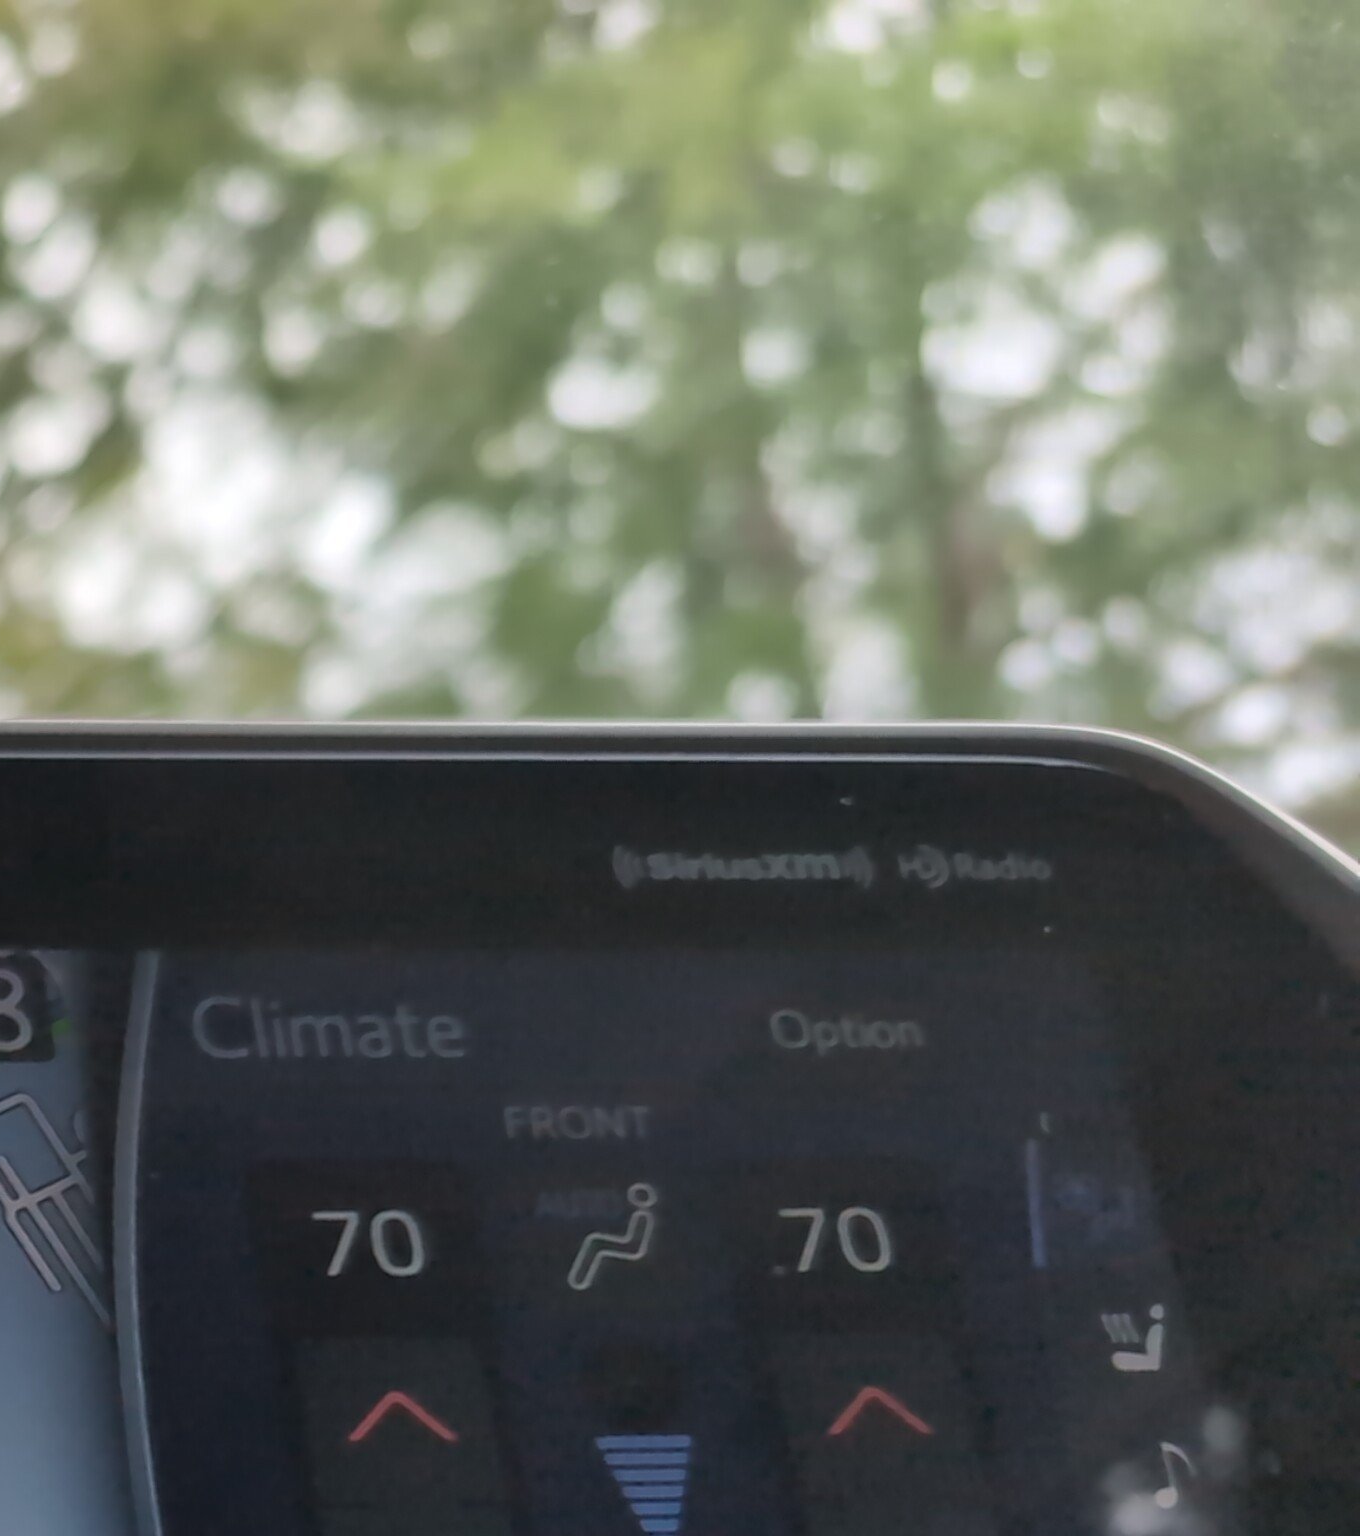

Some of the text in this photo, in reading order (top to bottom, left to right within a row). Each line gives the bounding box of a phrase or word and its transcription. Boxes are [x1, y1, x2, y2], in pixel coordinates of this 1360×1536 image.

[192, 996, 467, 1060] Climate
[770, 1008, 925, 1057] Option
[503, 1104, 651, 1141] FRONT
[310, 1208, 426, 1277] 70
[778, 1206, 894, 1273] 70
